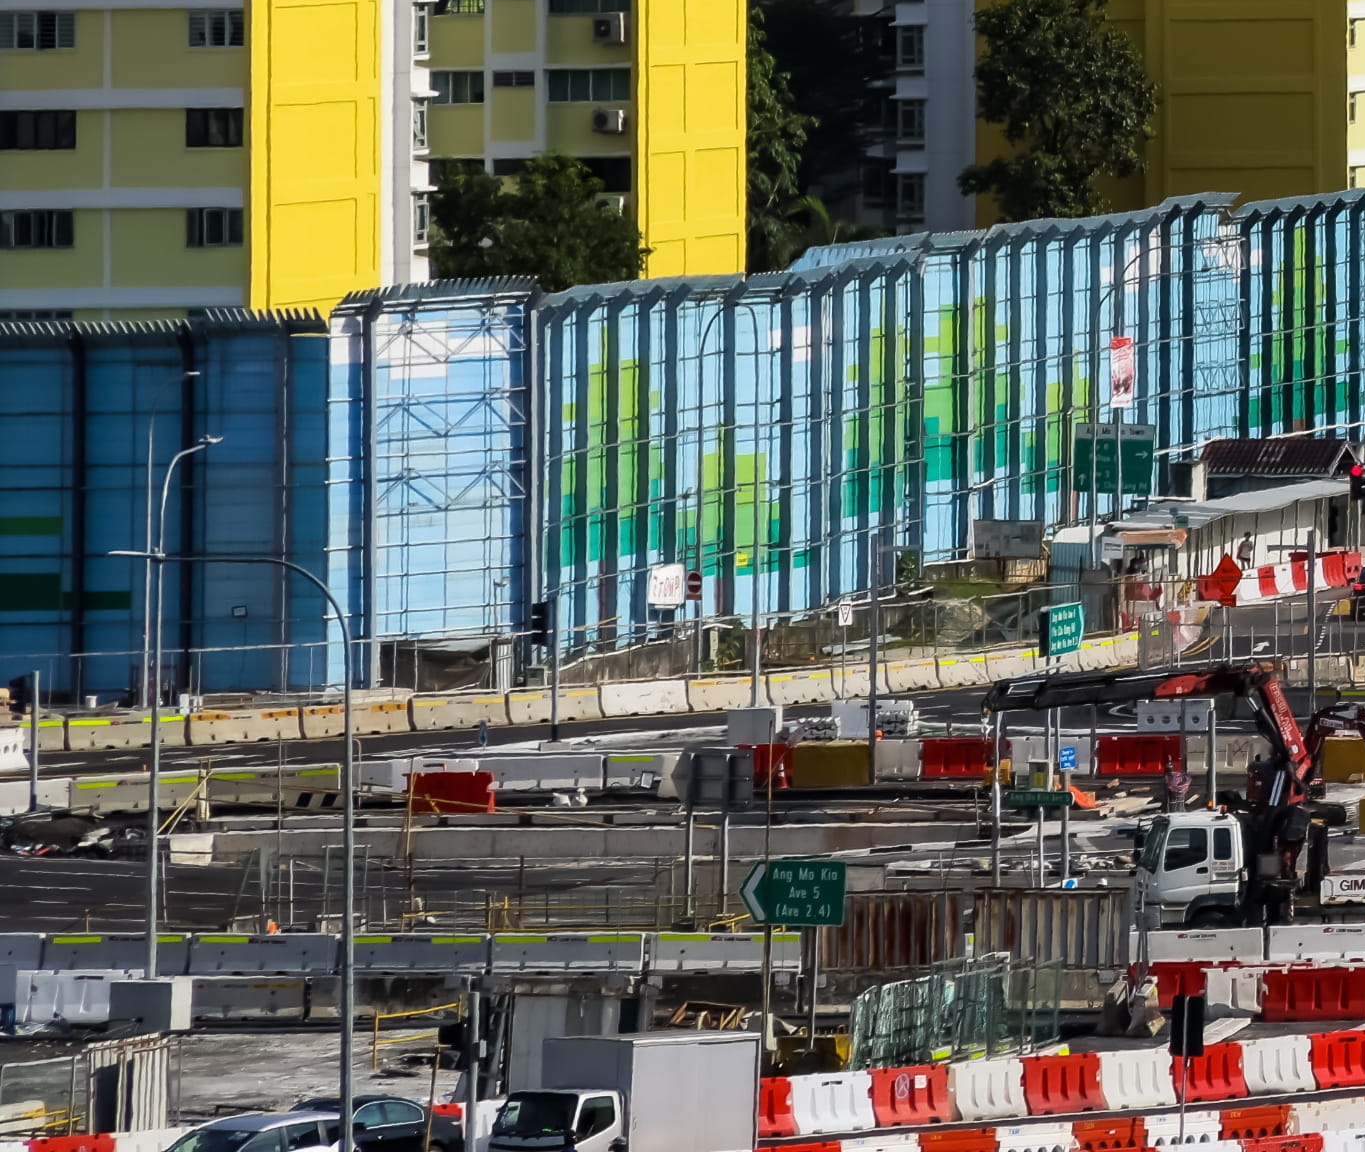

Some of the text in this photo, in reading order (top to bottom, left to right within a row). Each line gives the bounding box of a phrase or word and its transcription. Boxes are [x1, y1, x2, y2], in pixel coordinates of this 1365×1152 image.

[773, 868, 838, 882] Ang Mo Kio
[1340, 879, 1365, 891] GIM
[789, 886, 820, 899] Ave 5
[775, 904, 799, 918] (Ave
